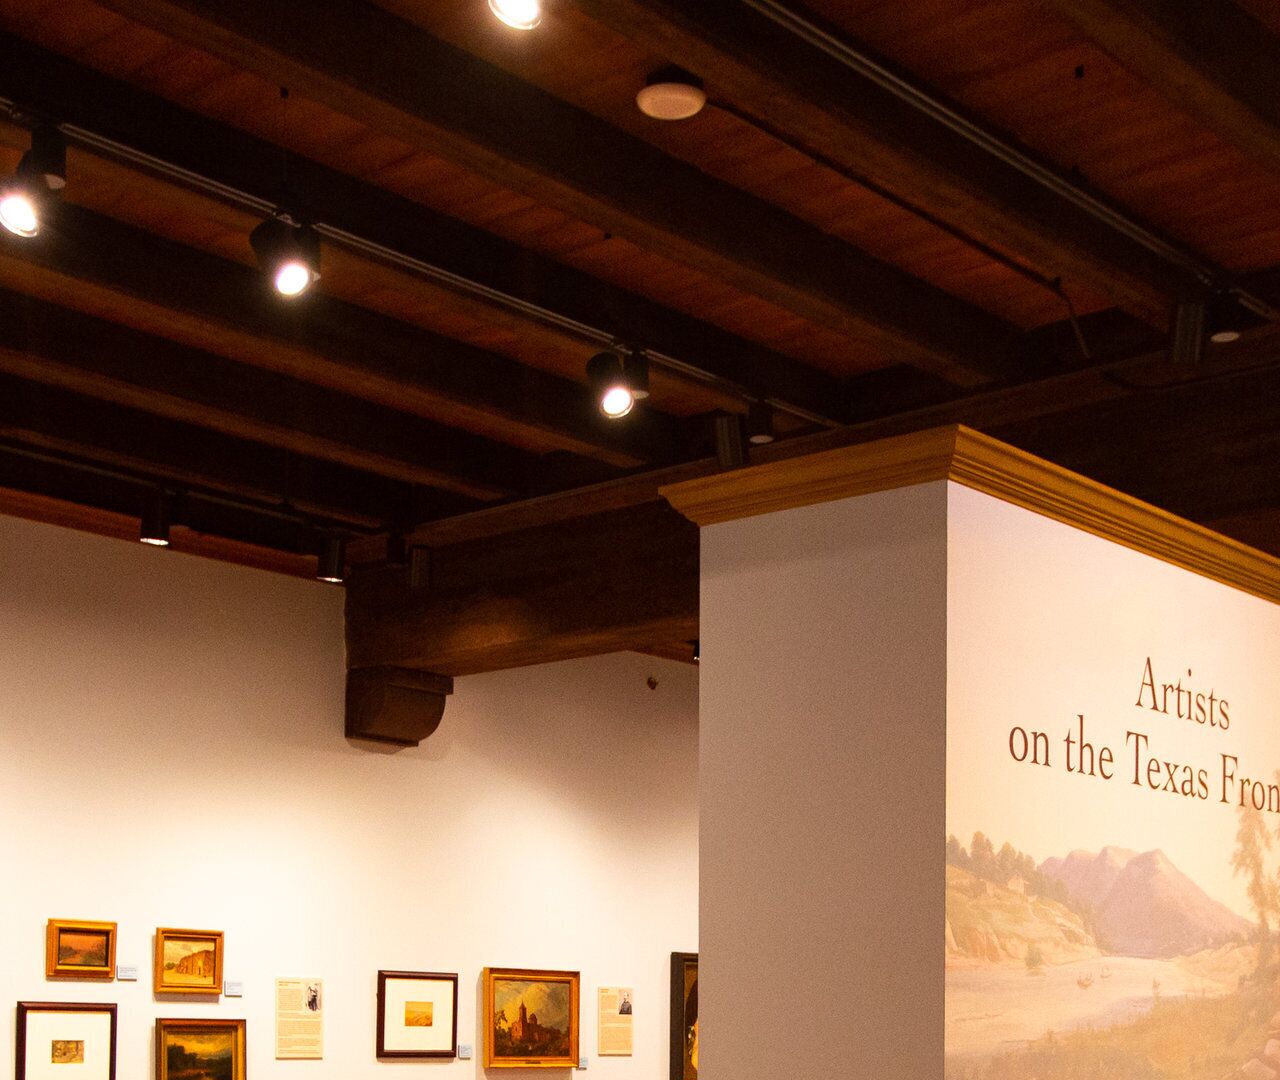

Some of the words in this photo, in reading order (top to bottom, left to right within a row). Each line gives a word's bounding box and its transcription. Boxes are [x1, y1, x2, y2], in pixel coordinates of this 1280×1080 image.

[1135, 657, 1230, 730] Artists
[1009, 726, 1050, 767] on
[1063, 715, 1114, 780] the
[1126, 731, 1209, 801] Texas
